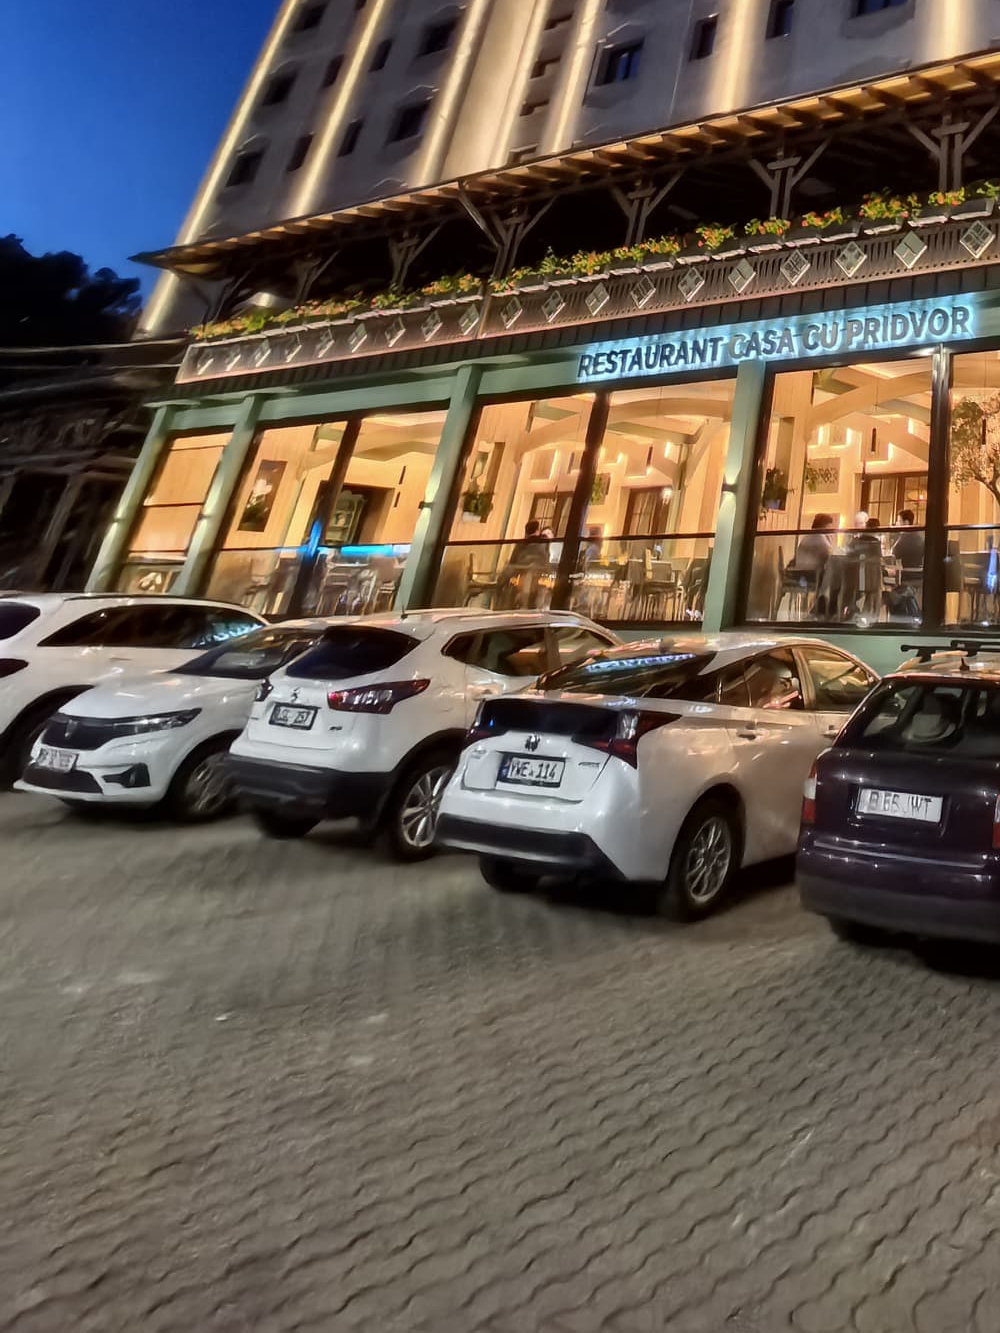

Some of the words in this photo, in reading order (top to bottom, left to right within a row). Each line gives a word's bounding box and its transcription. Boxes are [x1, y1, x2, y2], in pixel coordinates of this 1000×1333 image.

[577, 336, 723, 378] RESTAURANT
[728, 327, 795, 360] CASA
[802, 321, 839, 351] CU
[846, 305, 970, 348] PRIDVOR
